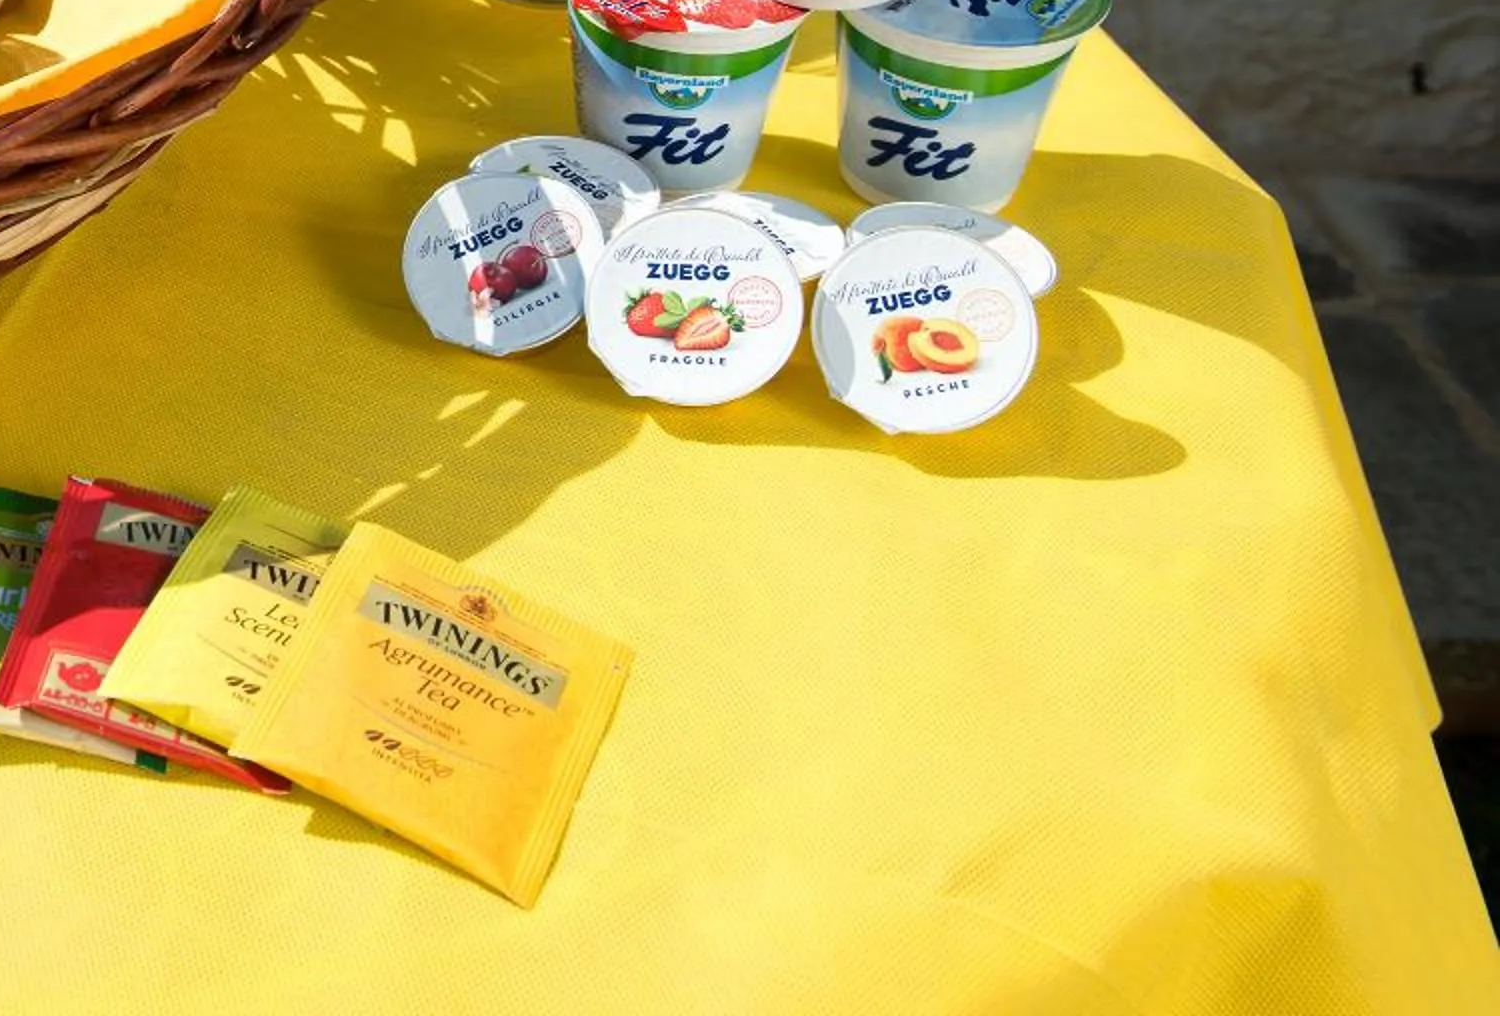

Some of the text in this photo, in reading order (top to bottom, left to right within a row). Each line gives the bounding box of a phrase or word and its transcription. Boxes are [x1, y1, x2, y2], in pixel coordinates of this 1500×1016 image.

[623, 113, 731, 166] Fit
[866, 115, 978, 180] Fit
[549, 161, 609, 202] ZUEGG
[449, 216, 524, 261] ZUEGG
[646, 262, 731, 281] ZUEGG
[493, 290, 561, 327] CILIEGIE
[865, 284, 953, 316] ZUEGG
[649, 353, 728, 367] FRAGOLE
[903, 379, 971, 400] PESCHE
[265, 602, 300, 631] Le
[374, 598, 551, 698] TWININGS
[416, 677, 462, 712] Tea
